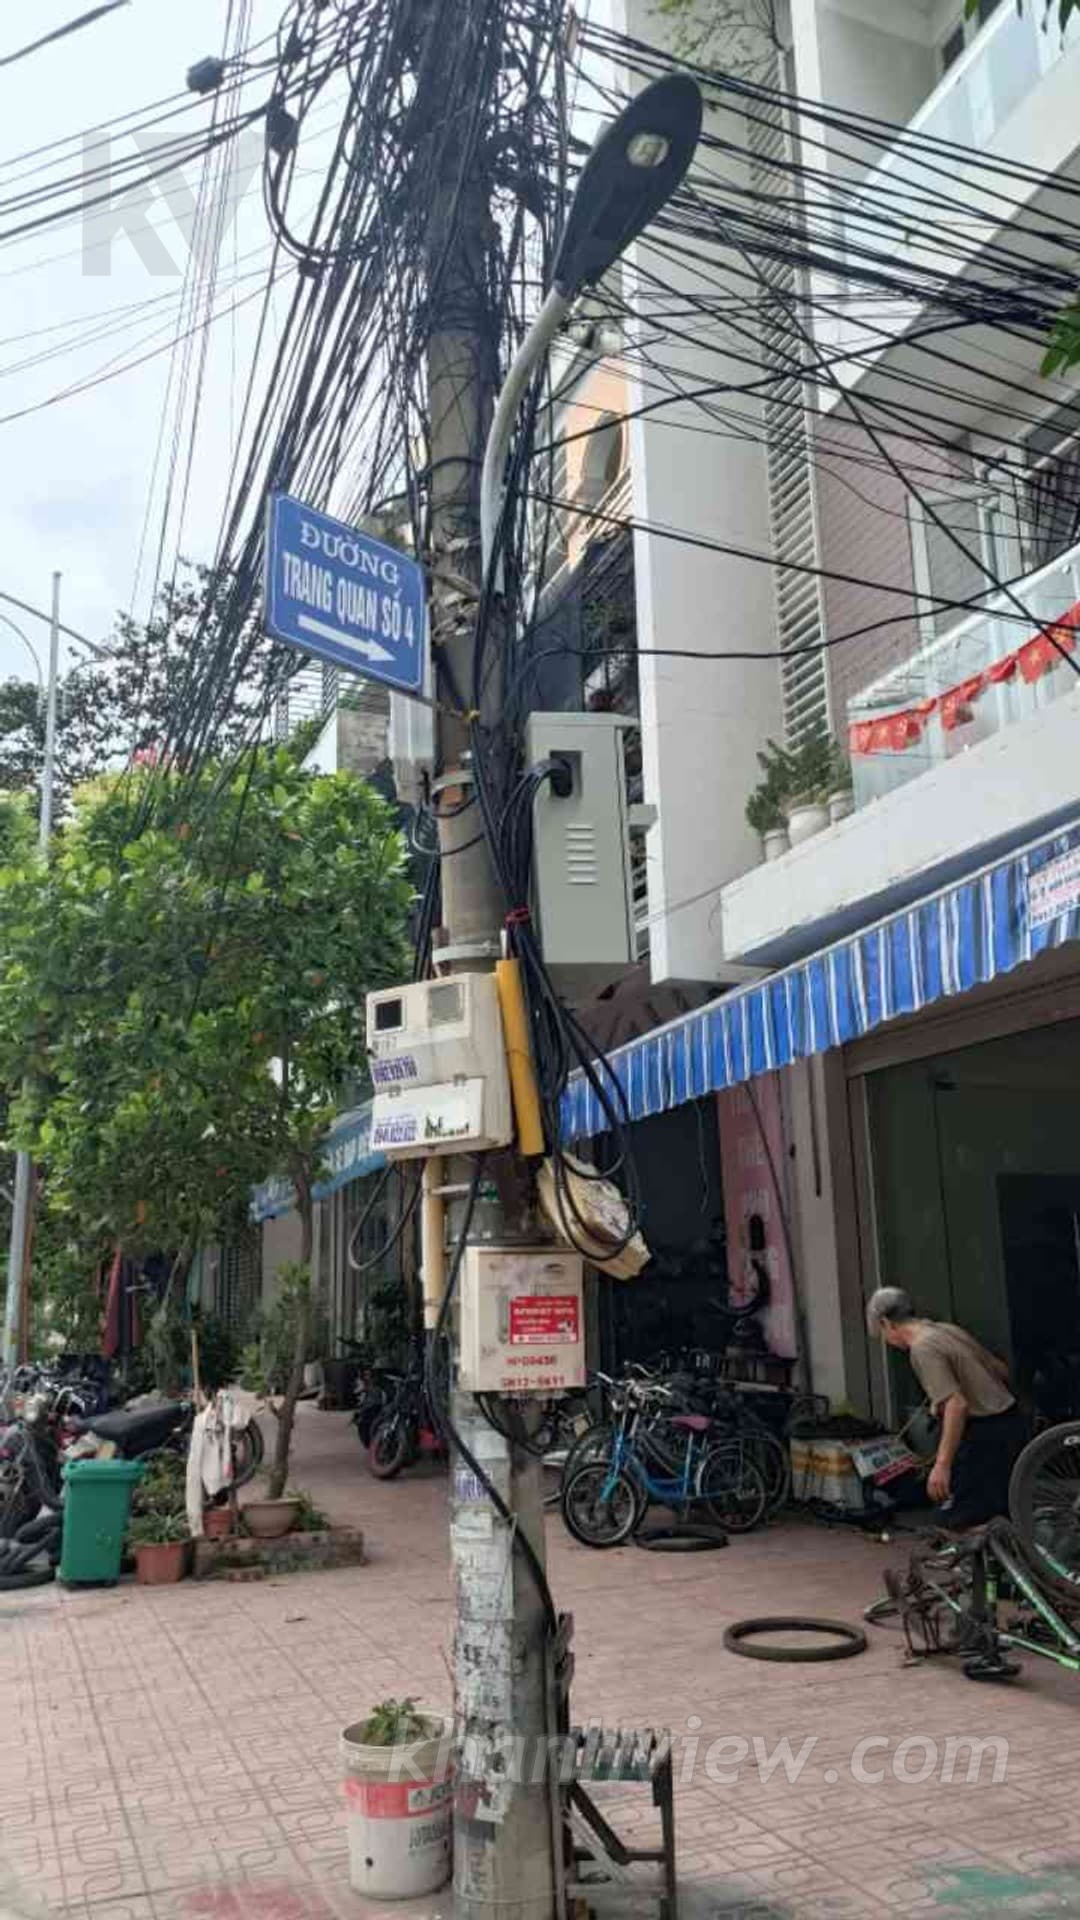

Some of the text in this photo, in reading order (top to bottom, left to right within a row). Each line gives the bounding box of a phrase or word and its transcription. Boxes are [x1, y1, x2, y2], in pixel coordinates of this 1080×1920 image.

[301, 520, 400, 585] ĐƯỜNG
[283, 551, 415, 649] TRANG QUAN SỐ 4
